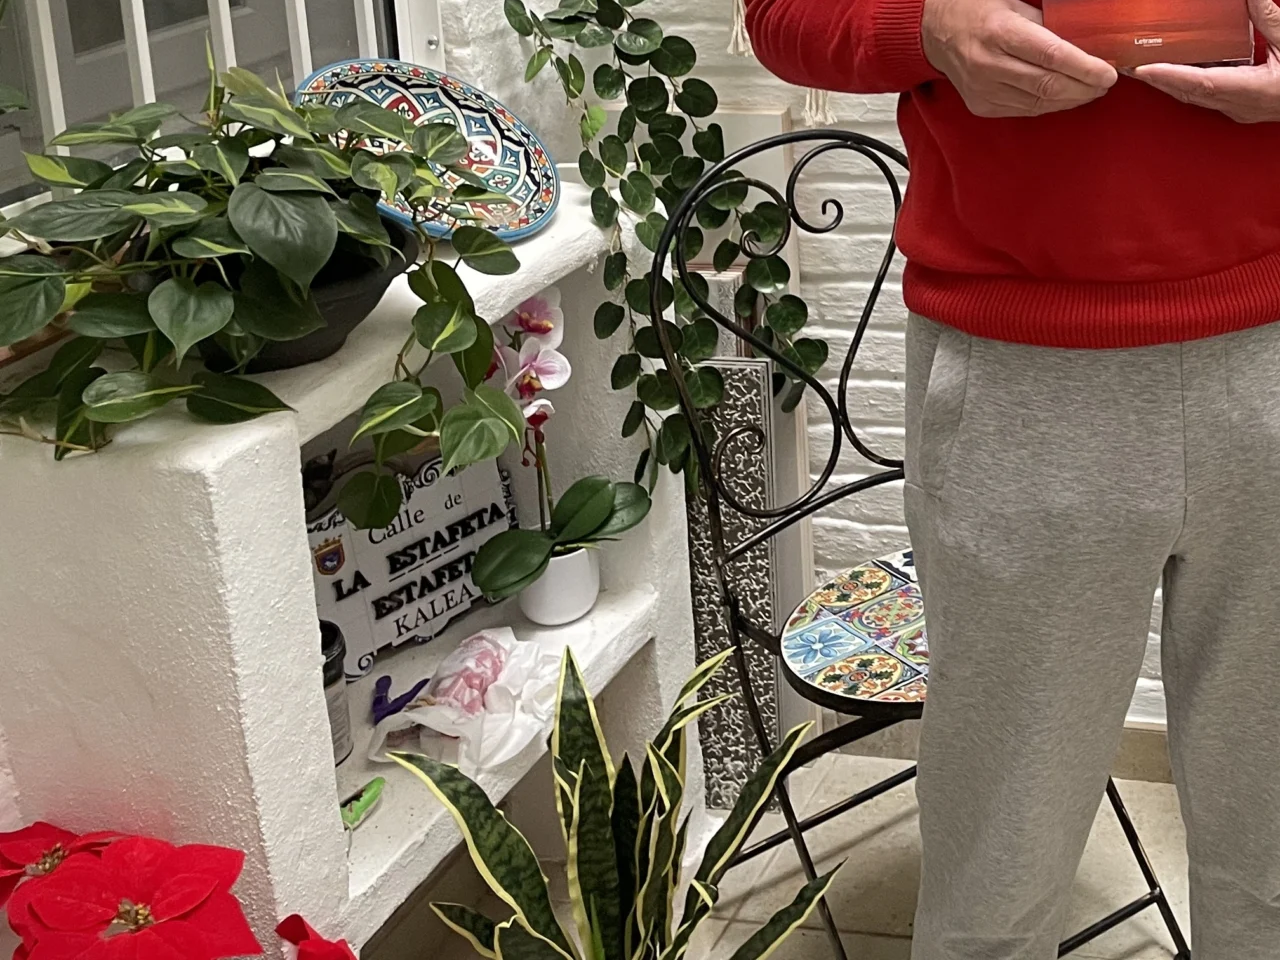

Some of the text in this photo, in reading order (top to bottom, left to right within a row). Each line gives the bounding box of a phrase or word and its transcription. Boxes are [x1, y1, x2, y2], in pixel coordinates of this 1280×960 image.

[368, 493, 463, 544] Calle de
[332, 502, 506, 602] LA ESTAFETA
[371, 546, 482, 620] ESTAFET
[393, 582, 475, 639] KALEA
